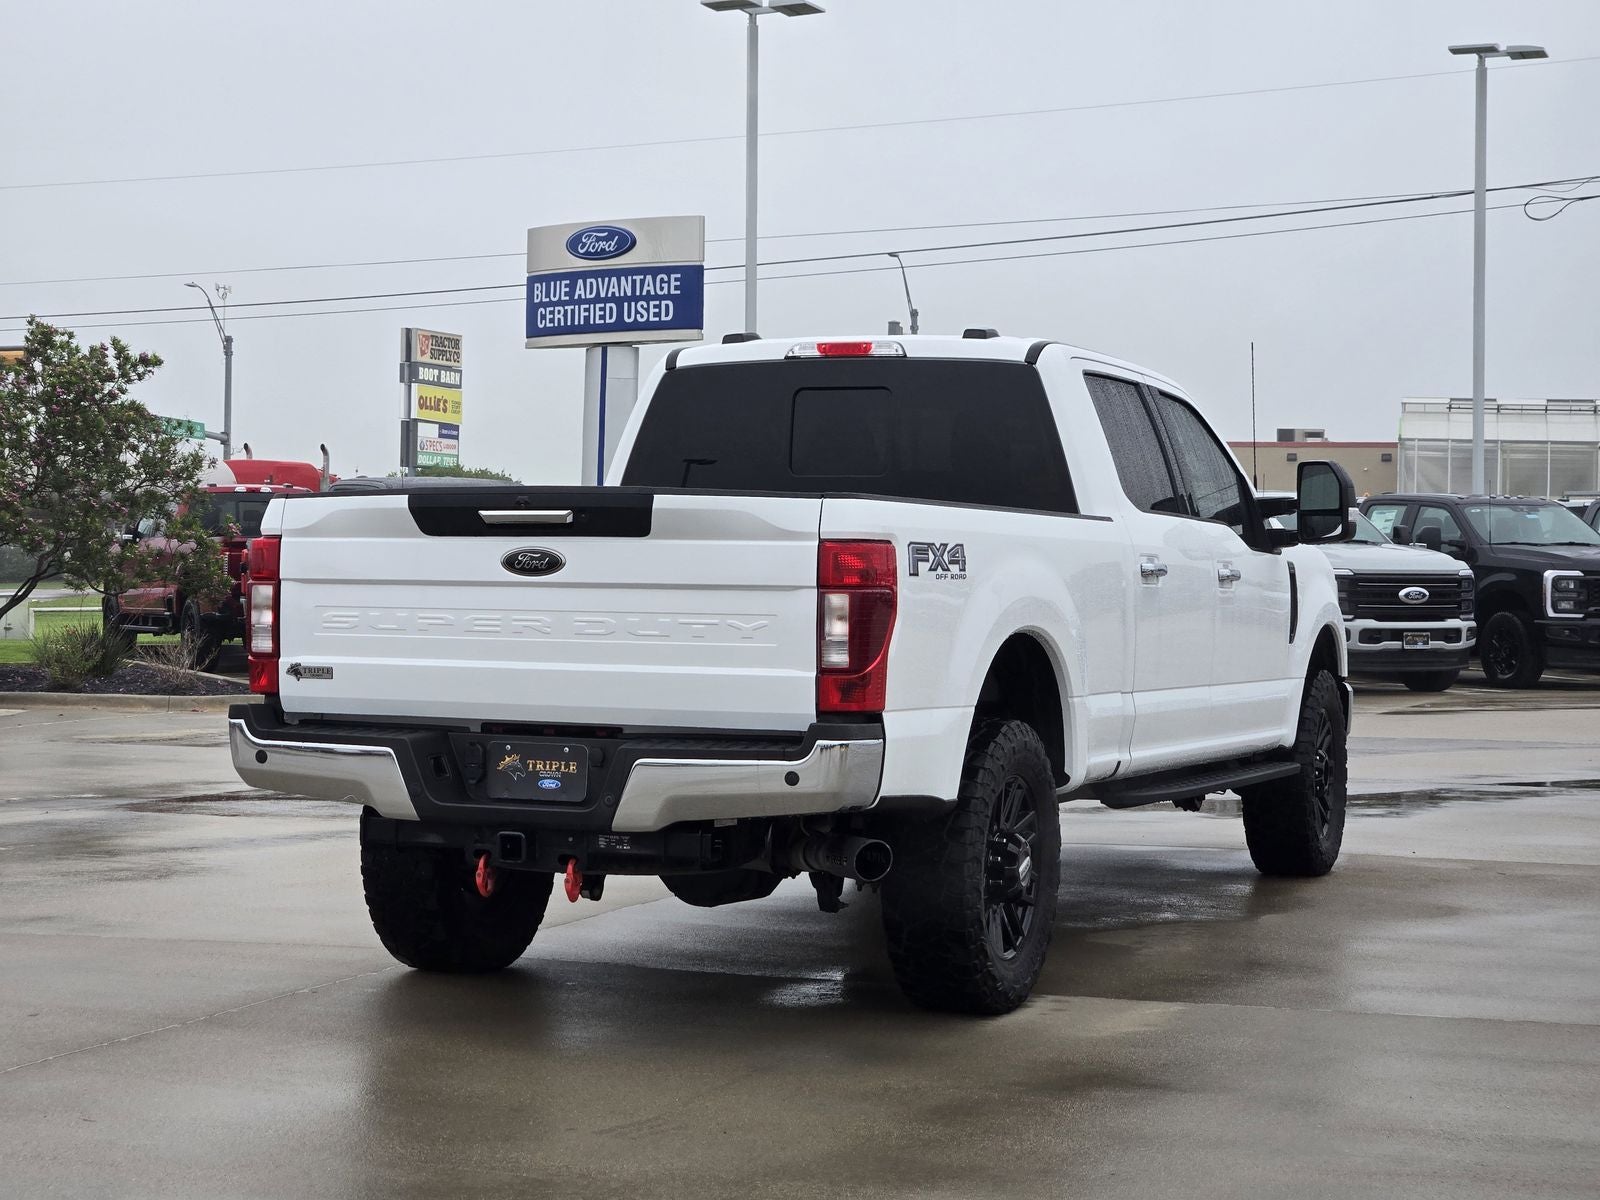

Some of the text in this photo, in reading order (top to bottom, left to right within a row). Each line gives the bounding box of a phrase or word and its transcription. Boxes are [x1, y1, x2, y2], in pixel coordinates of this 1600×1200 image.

[578, 231, 618, 253] Ford
[533, 273, 681, 303] BLUE ADVANTAGE
[537, 300, 674, 328] CERTIFIED USED
[430, 334, 461, 350] TRACTOR
[430, 348, 453, 362] SUPPLY
[418, 367, 461, 385] BOOT BARN
[514, 552, 550, 569] Ford
[907, 541, 967, 576] FX4
[322, 612, 769, 640] SUPER DUTY
[526, 760, 577, 773] TRIPLE
